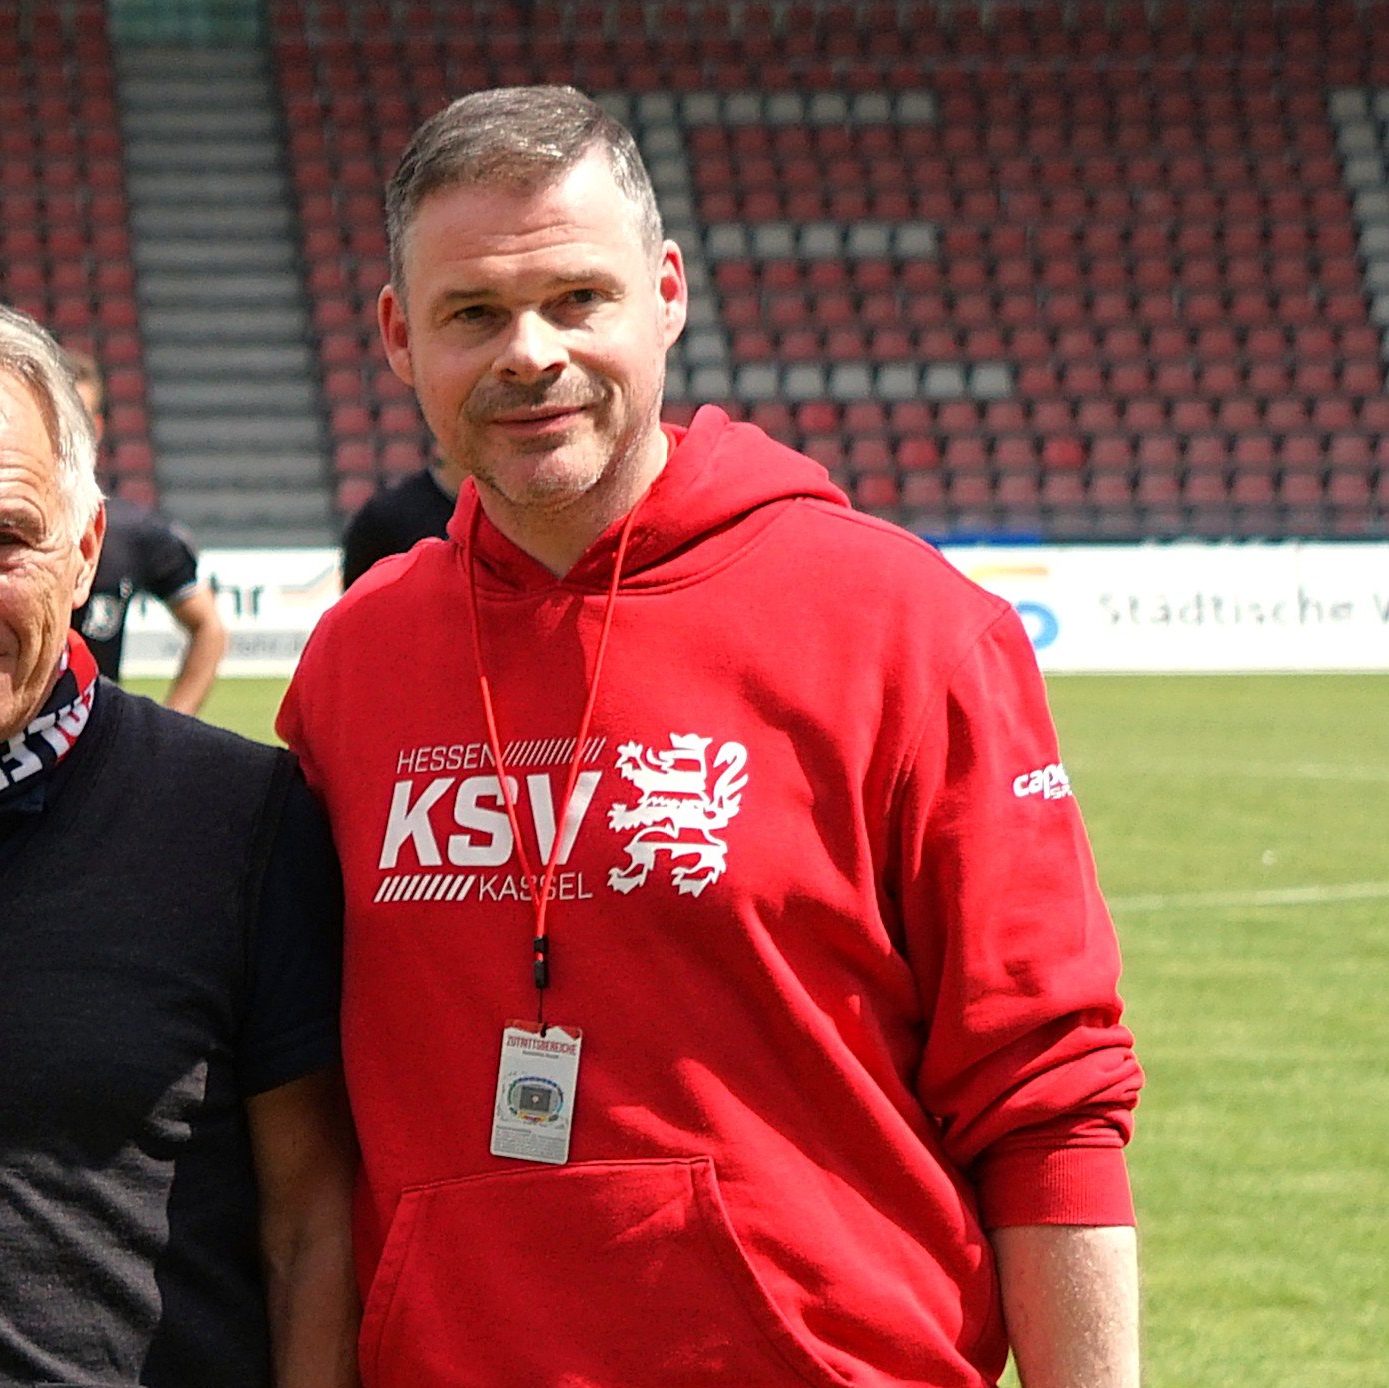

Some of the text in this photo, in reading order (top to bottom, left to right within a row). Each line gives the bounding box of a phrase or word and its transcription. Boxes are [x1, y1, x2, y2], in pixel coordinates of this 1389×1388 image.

[396, 742, 497, 775] HESSEN
[378, 770, 603, 870] KSV
[477, 872, 594, 902] KASSEL
